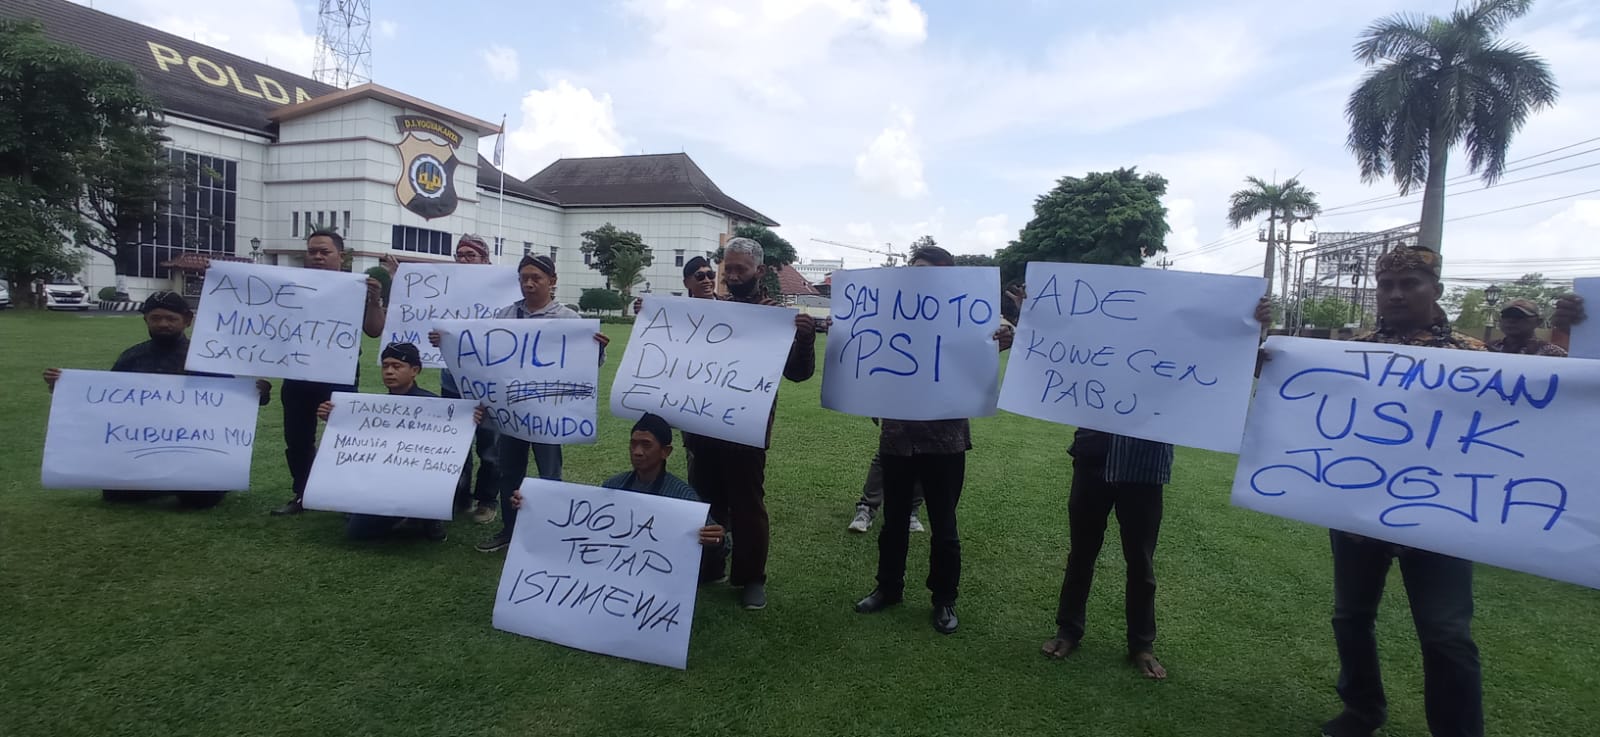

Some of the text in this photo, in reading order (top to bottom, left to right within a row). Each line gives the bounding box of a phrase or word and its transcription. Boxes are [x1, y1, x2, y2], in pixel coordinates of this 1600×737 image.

[209, 274, 318, 310] ADE
[404, 272, 449, 299] PSI
[1030, 274, 1147, 321] ADE
[400, 304, 470, 323] BUKAN
[835, 283, 993, 328] SAY NO TO
[457, 328, 566, 369] ADILI
[839, 328, 941, 382] PSI
[1025, 329, 1116, 366] KOWE
[86, 386, 224, 407] UCAPAN MU
[460, 375, 498, 403] ADE
[1279, 350, 1559, 410] JANGAN
[349, 400, 423, 419] TANGKAP
[358, 416, 458, 435] ADE ARMANDO
[484, 405, 594, 437] ARMANDO
[1316, 394, 1525, 458] USIK
[105, 422, 253, 447] KUBURAN MU
[383, 453, 420, 468] ANAK
[1250, 447, 1568, 530] JOGJA
[547, 498, 658, 542] JOGJA
[561, 537, 673, 576] TETAP
[508, 568, 681, 632] ISTIMEWA
